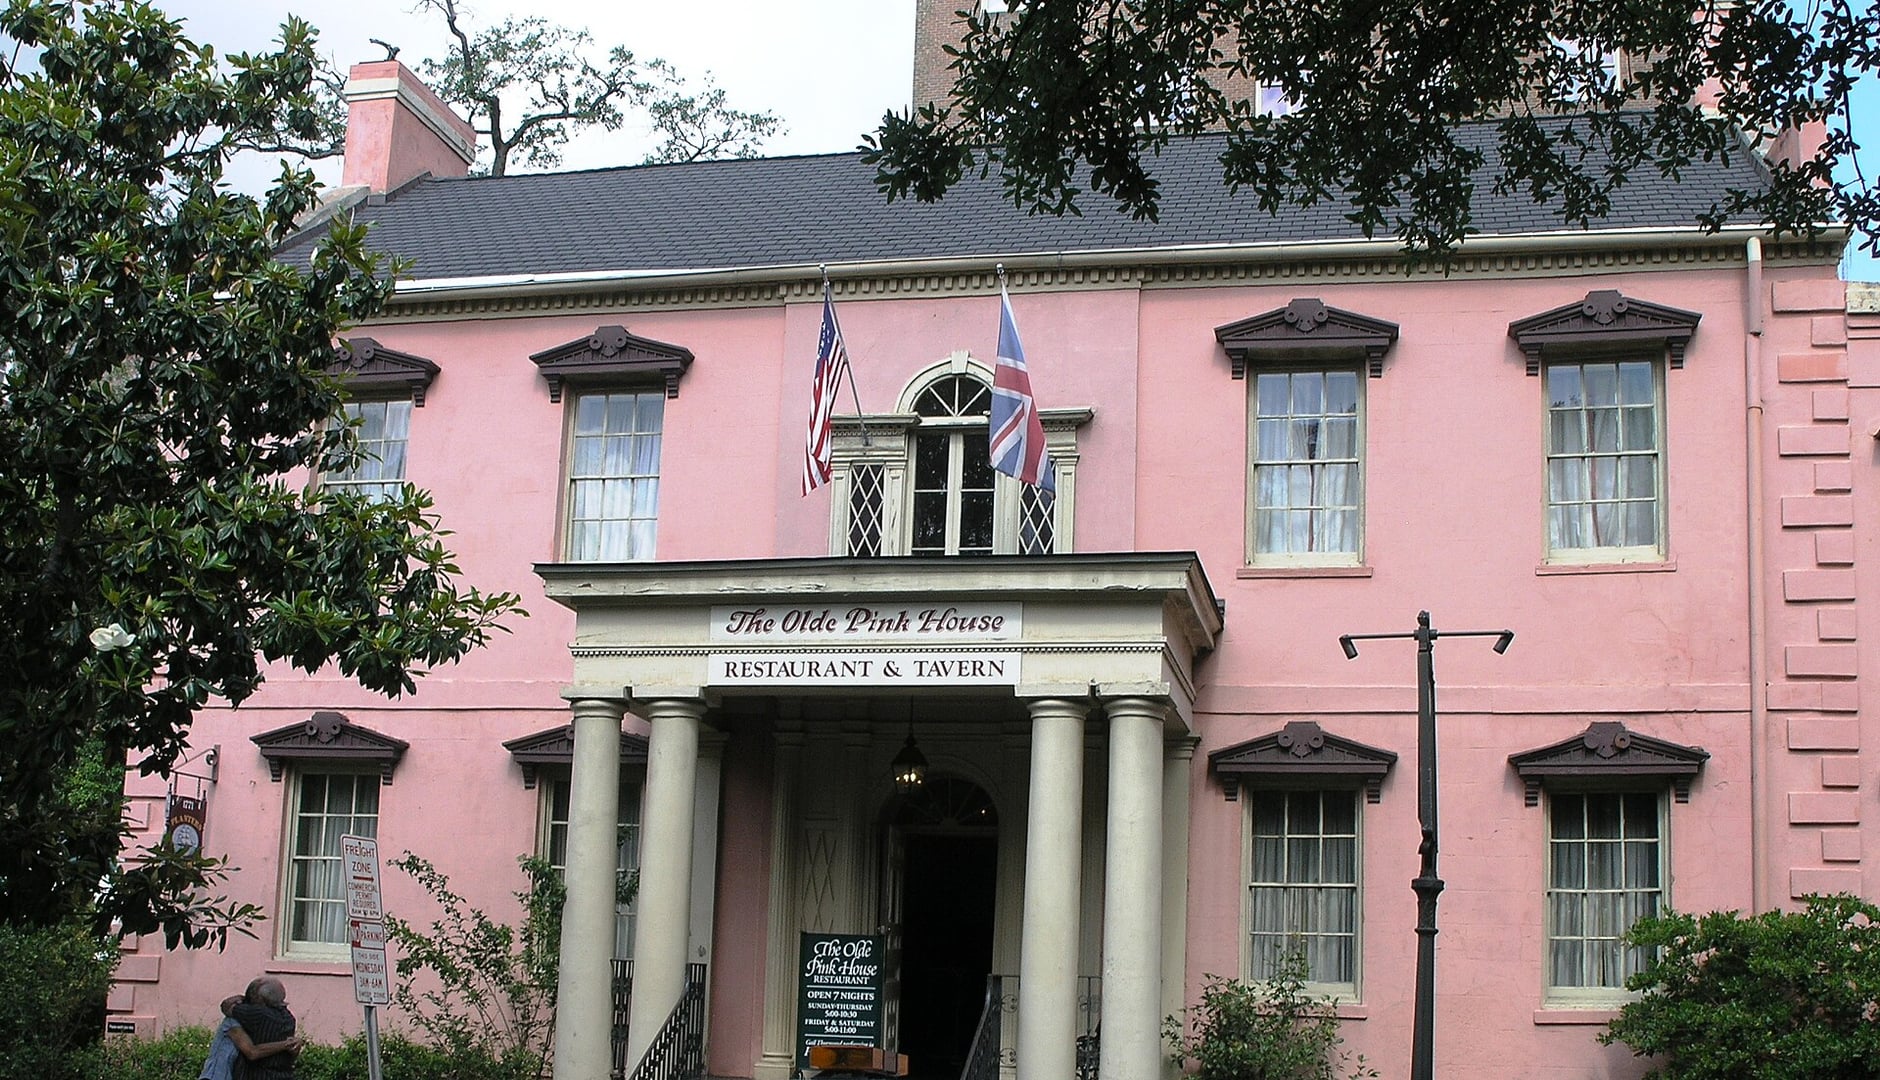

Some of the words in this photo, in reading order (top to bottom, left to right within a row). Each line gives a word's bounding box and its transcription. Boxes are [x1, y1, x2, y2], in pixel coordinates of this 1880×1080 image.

[725, 607, 776, 635] The
[781, 607, 836, 635] Olde
[844, 606, 910, 635] Pink
[917, 607, 1005, 634] House
[724, 660, 873, 679] RESTAURANT
[883, 659, 903, 678] &
[913, 659, 1005, 678] TAVERN
[345, 844, 376, 859] FREIGHT
[352, 861, 372, 874] ZONE
[348, 882, 378, 893] COMMERCIAL
[355, 891, 373, 901] PERMIT
[814, 939, 842, 957] The
[843, 939, 873, 959] Olde
[356, 963, 384, 975] WEDNESDAY
[805, 954, 840, 977] Pink
[838, 957, 878, 976] House
[813, 975, 870, 985] RESTAURANT
[807, 991, 832, 999] OPEN
[833, 991, 840, 1001] 7
[840, 991, 875, 1001] NIGHTS
[805, 1018, 829, 1026] FRIDAY
